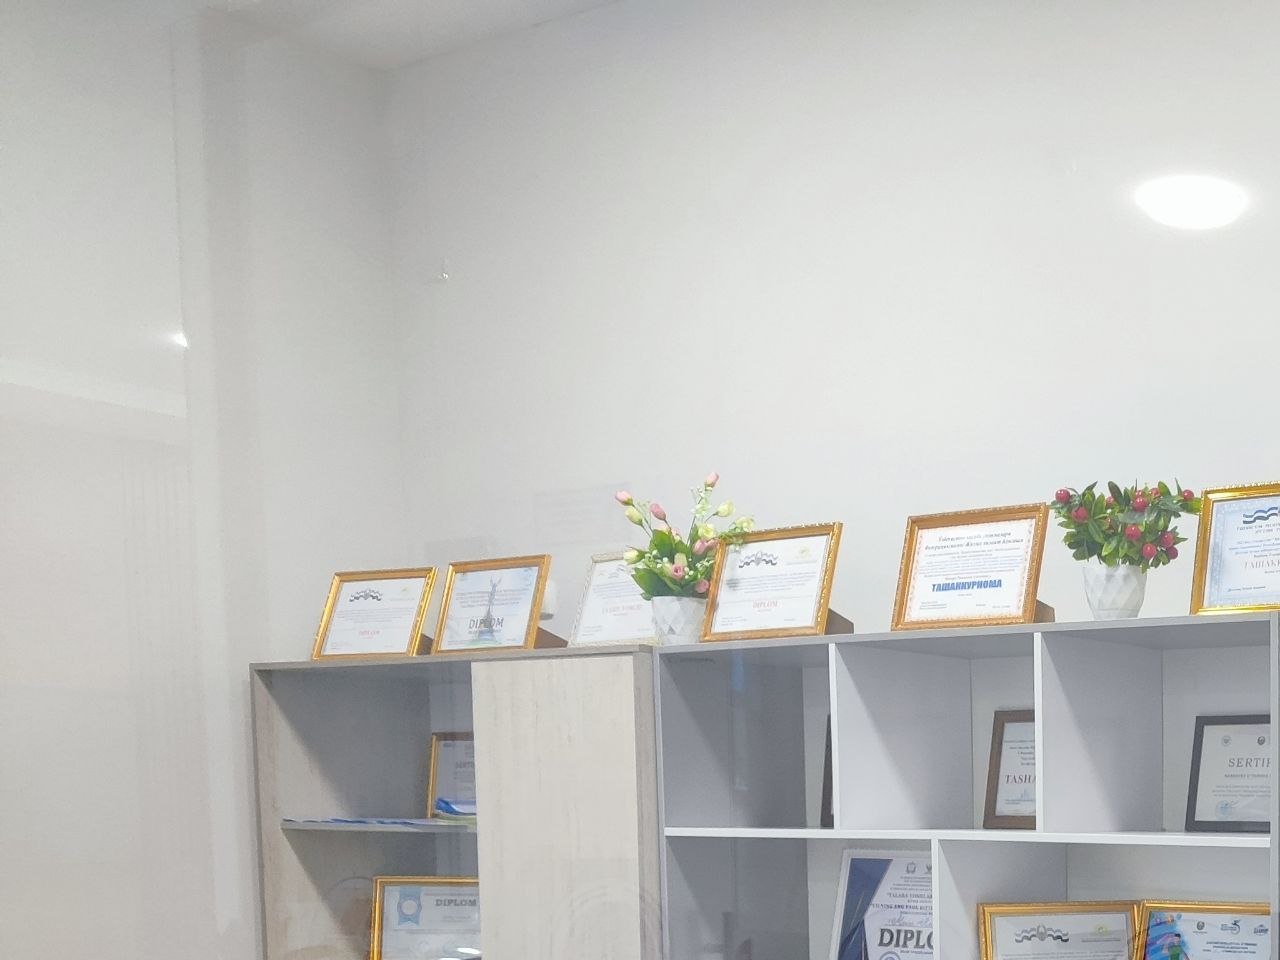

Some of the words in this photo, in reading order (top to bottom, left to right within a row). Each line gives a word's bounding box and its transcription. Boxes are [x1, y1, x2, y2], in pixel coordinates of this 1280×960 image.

[931, 579, 1002, 592] ТАШАККУРНОМА
[468, 616, 504, 630] DIPLOM
[435, 899, 477, 907] DIPLOM
